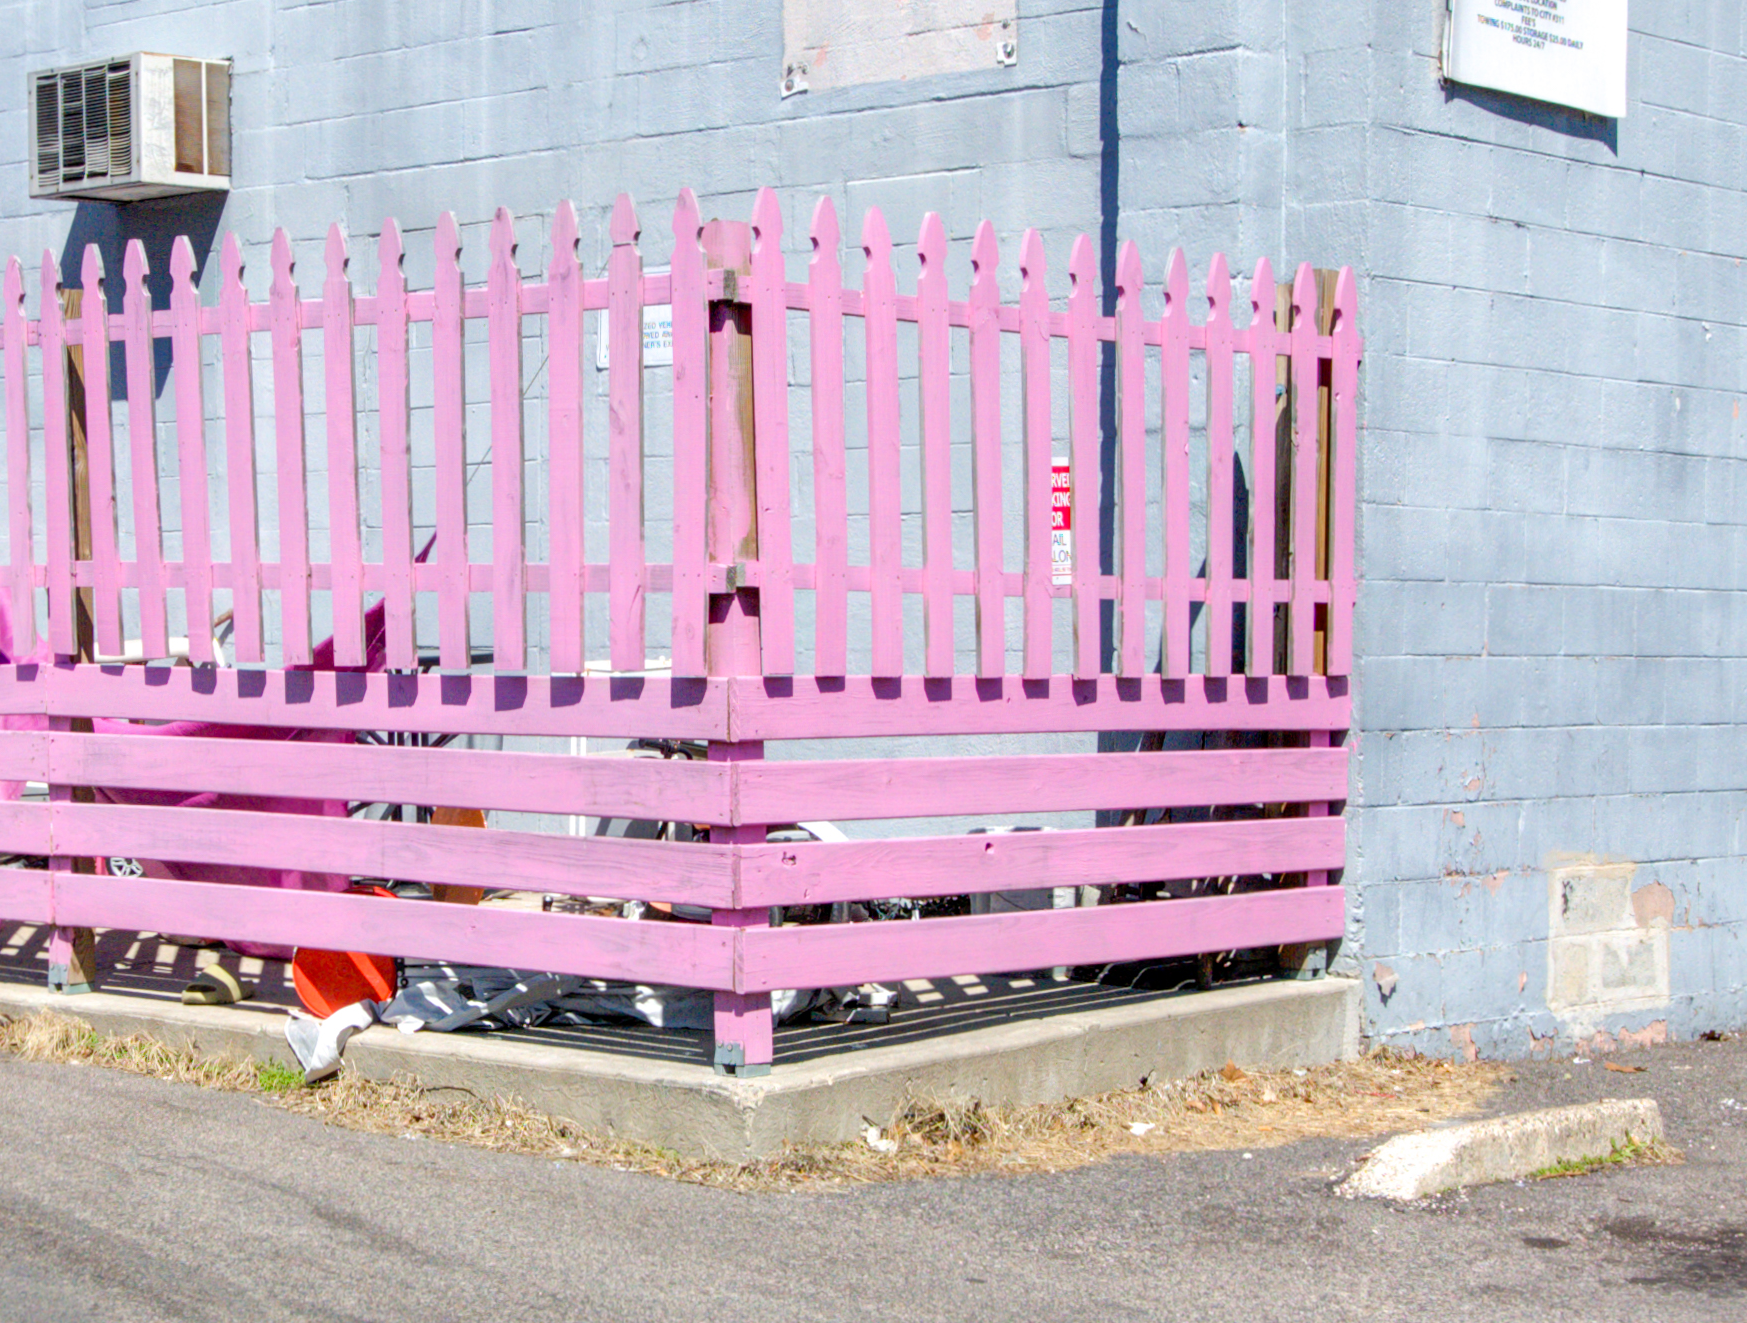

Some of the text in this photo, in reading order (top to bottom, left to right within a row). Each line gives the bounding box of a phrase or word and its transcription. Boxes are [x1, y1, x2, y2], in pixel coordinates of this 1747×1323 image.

[1531, 8, 1538, 17] TO
[1539, 10, 1551, 21] CITY
[1477, 14, 1498, 27] TOWING
[1523, 26, 1547, 40] STORAGE
[1567, 38, 1583, 49] DAILY
[1512, 35, 1544, 49] HOURS 24/7
